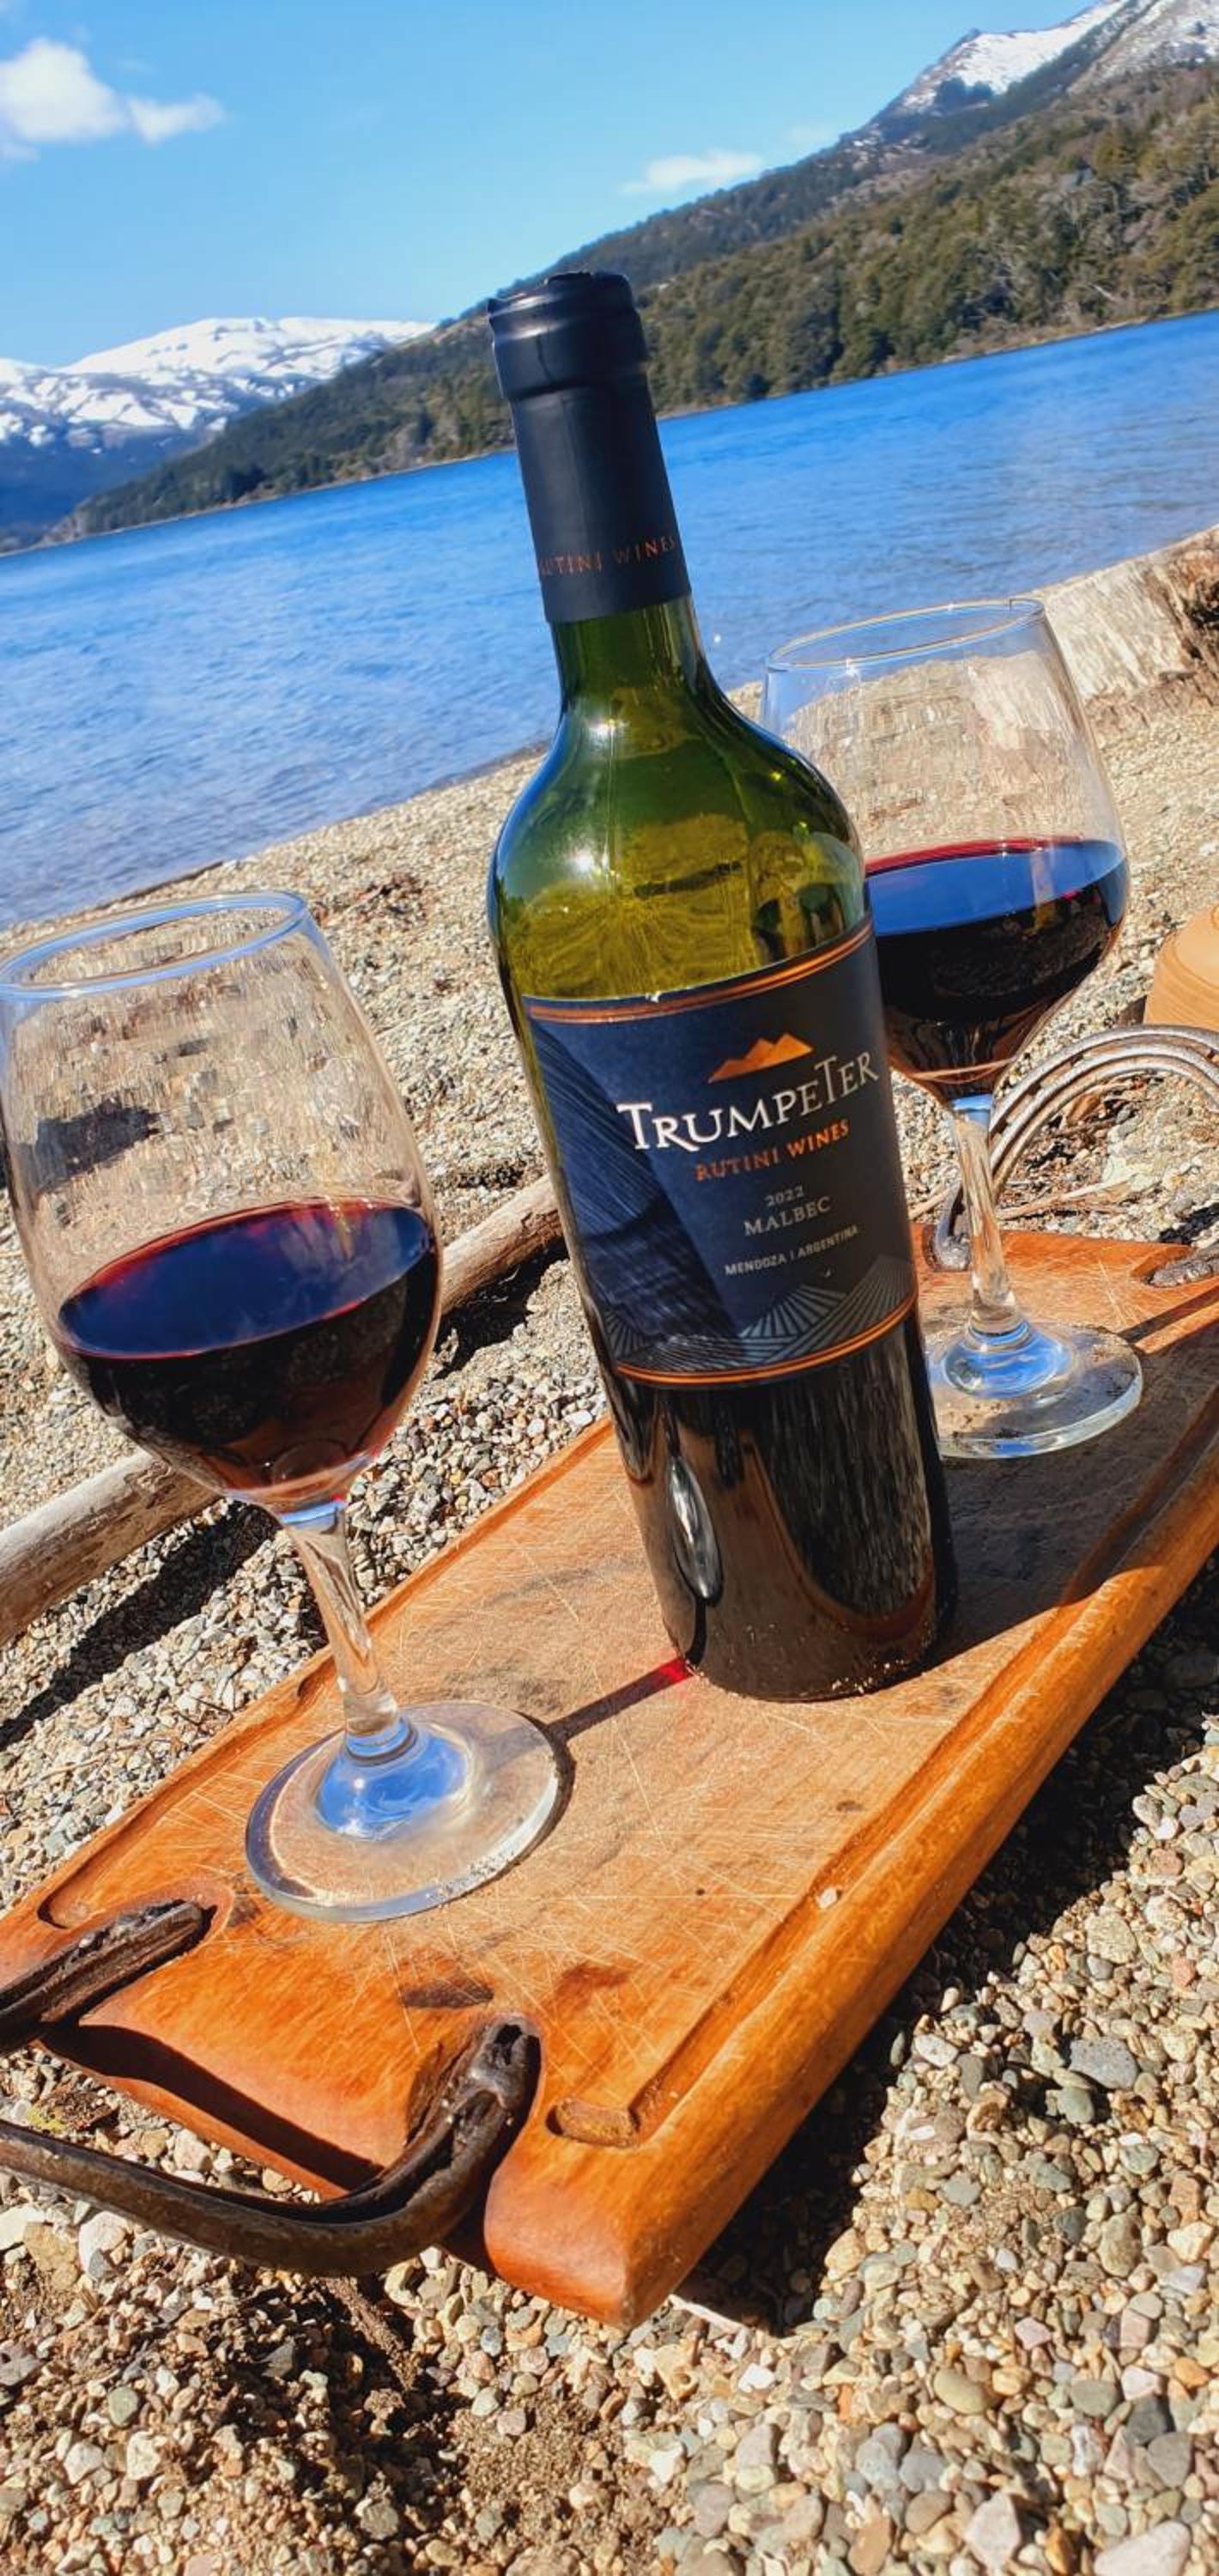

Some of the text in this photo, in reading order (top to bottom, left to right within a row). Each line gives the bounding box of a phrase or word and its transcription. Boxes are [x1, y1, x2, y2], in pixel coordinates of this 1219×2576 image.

[614, 536, 677, 564] WINES
[616, 1052, 880, 1152] TRUMPETER
[695, 1119, 850, 1182] RUTINI WINES
[743, 1196, 831, 1236] MALBEC
[764, 1185, 804, 1207] 2022
[725, 1253, 787, 1275] MENDOZA
[798, 1224, 858, 1258] ARGENTINA
